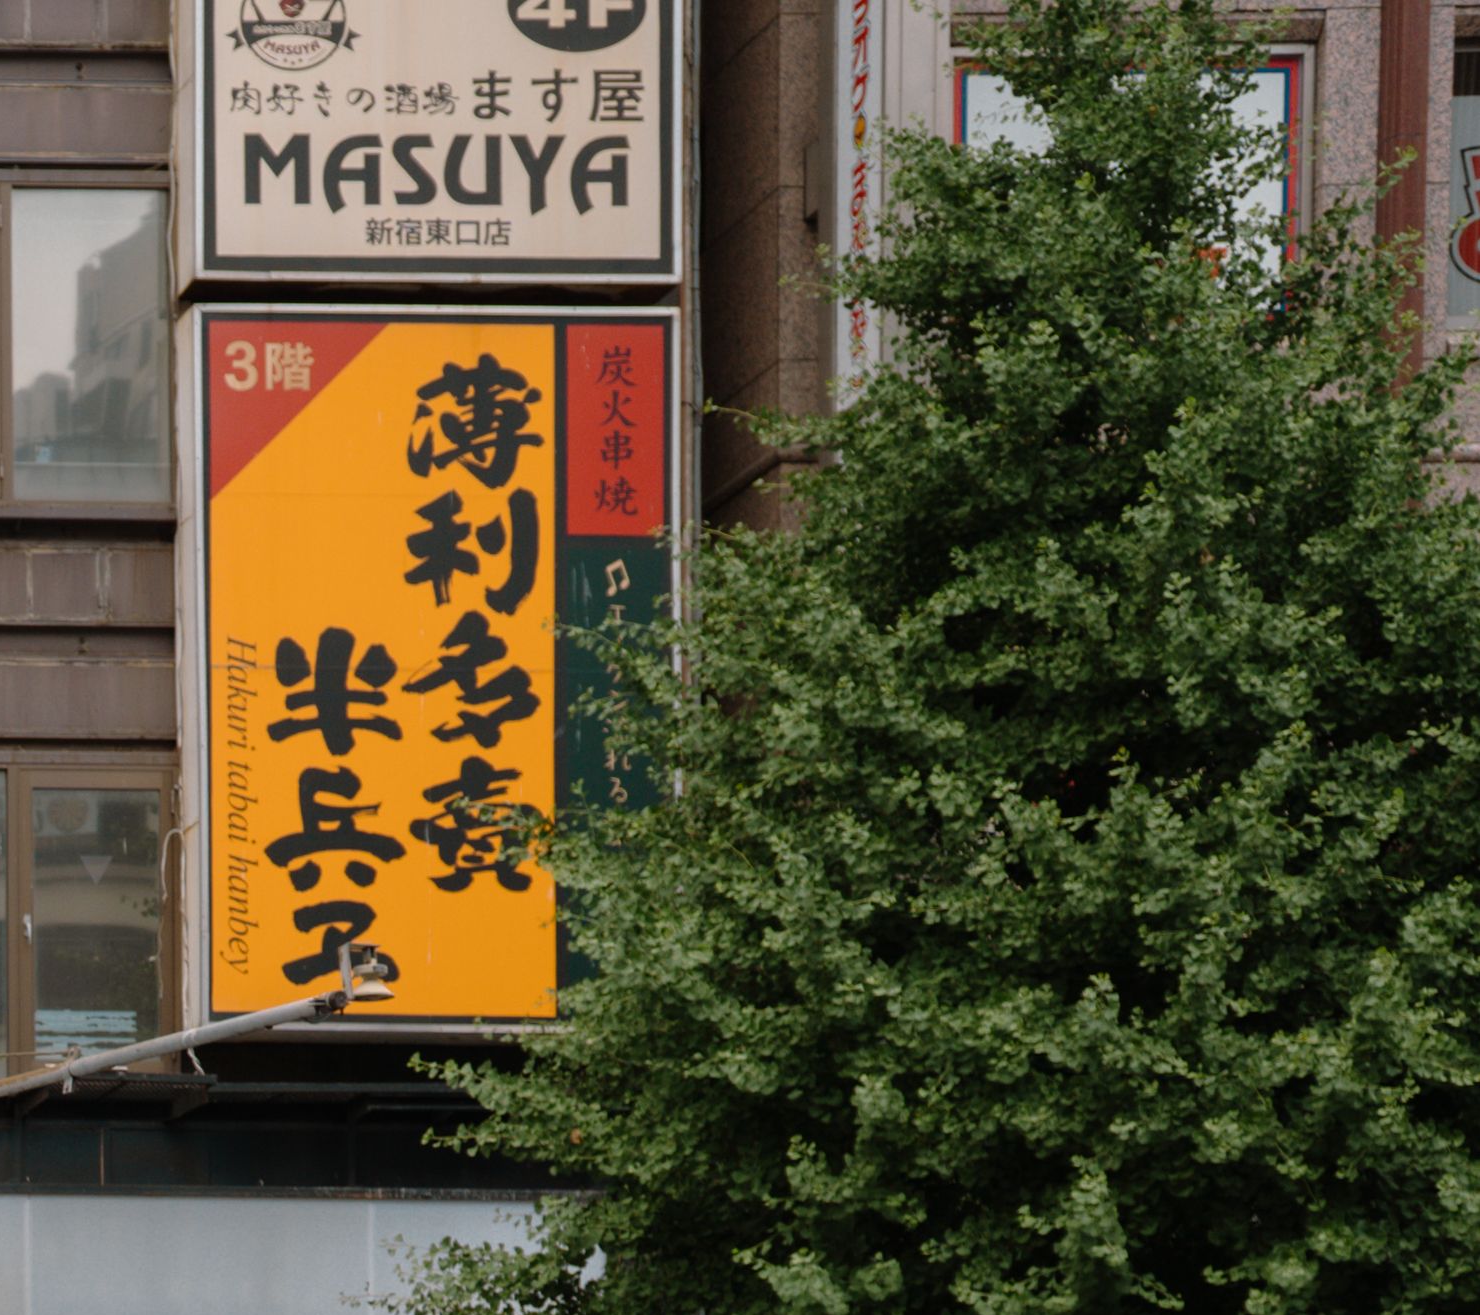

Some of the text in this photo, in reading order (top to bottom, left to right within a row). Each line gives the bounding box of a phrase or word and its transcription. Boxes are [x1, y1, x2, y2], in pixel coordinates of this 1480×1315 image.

[472, 69, 646, 123] ます屋
[242, 132, 632, 216] MASUYA
[364, 217, 512, 247] 新宿東口店
[223, 339, 315, 393] 3階
[226, 635, 259, 976] Hakuri tabai hanbey
